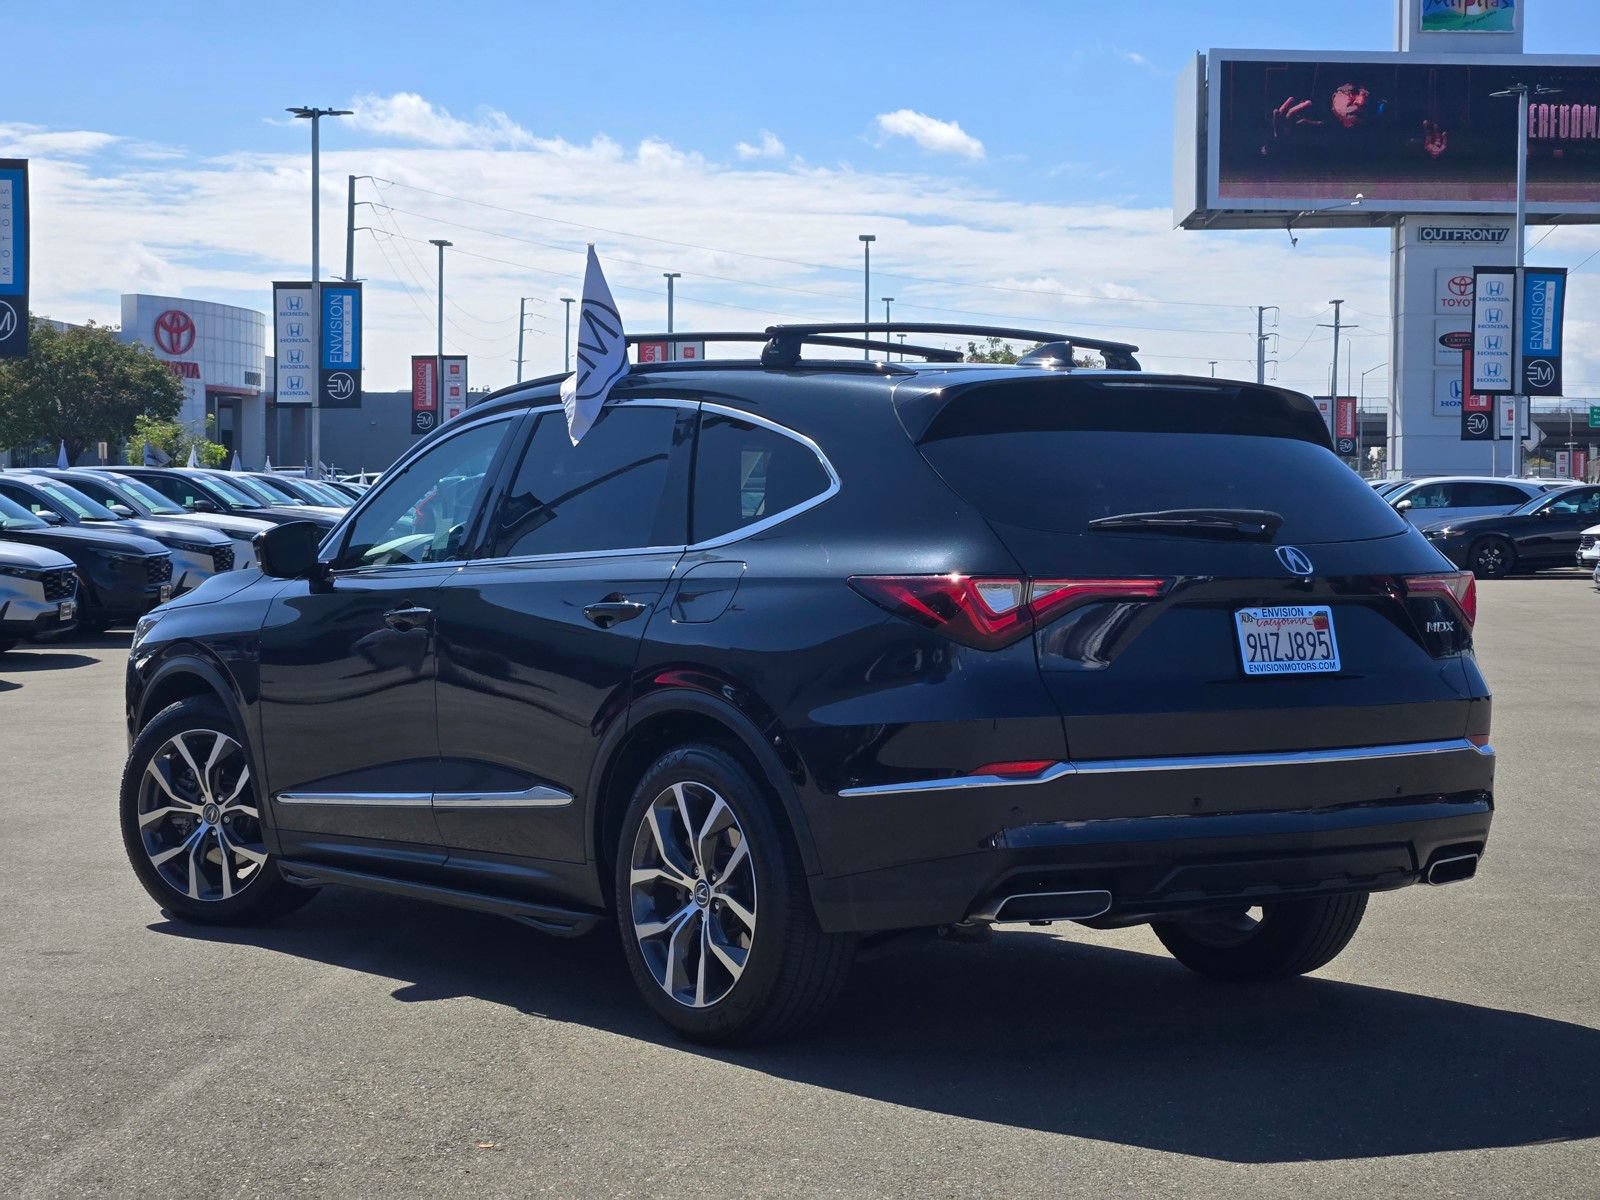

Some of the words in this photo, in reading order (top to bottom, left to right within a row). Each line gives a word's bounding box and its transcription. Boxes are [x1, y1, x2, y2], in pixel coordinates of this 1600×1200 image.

[1529, 103, 1600, 138] ERFORM
[2, 188, 10, 276] MOTORS
[1441, 298, 1473, 307] TOYO
[1530, 280, 1545, 350] ENVISION
[330, 294, 343, 363] ENVISION
[1262, 607, 1304, 618] ENVISION
[1256, 617, 1313, 631] California
[1426, 621, 1454, 633] MDX
[1246, 631, 1331, 662] 9HZJ895
[1249, 661, 1337, 673] ENVISIONMOTORS.COM
